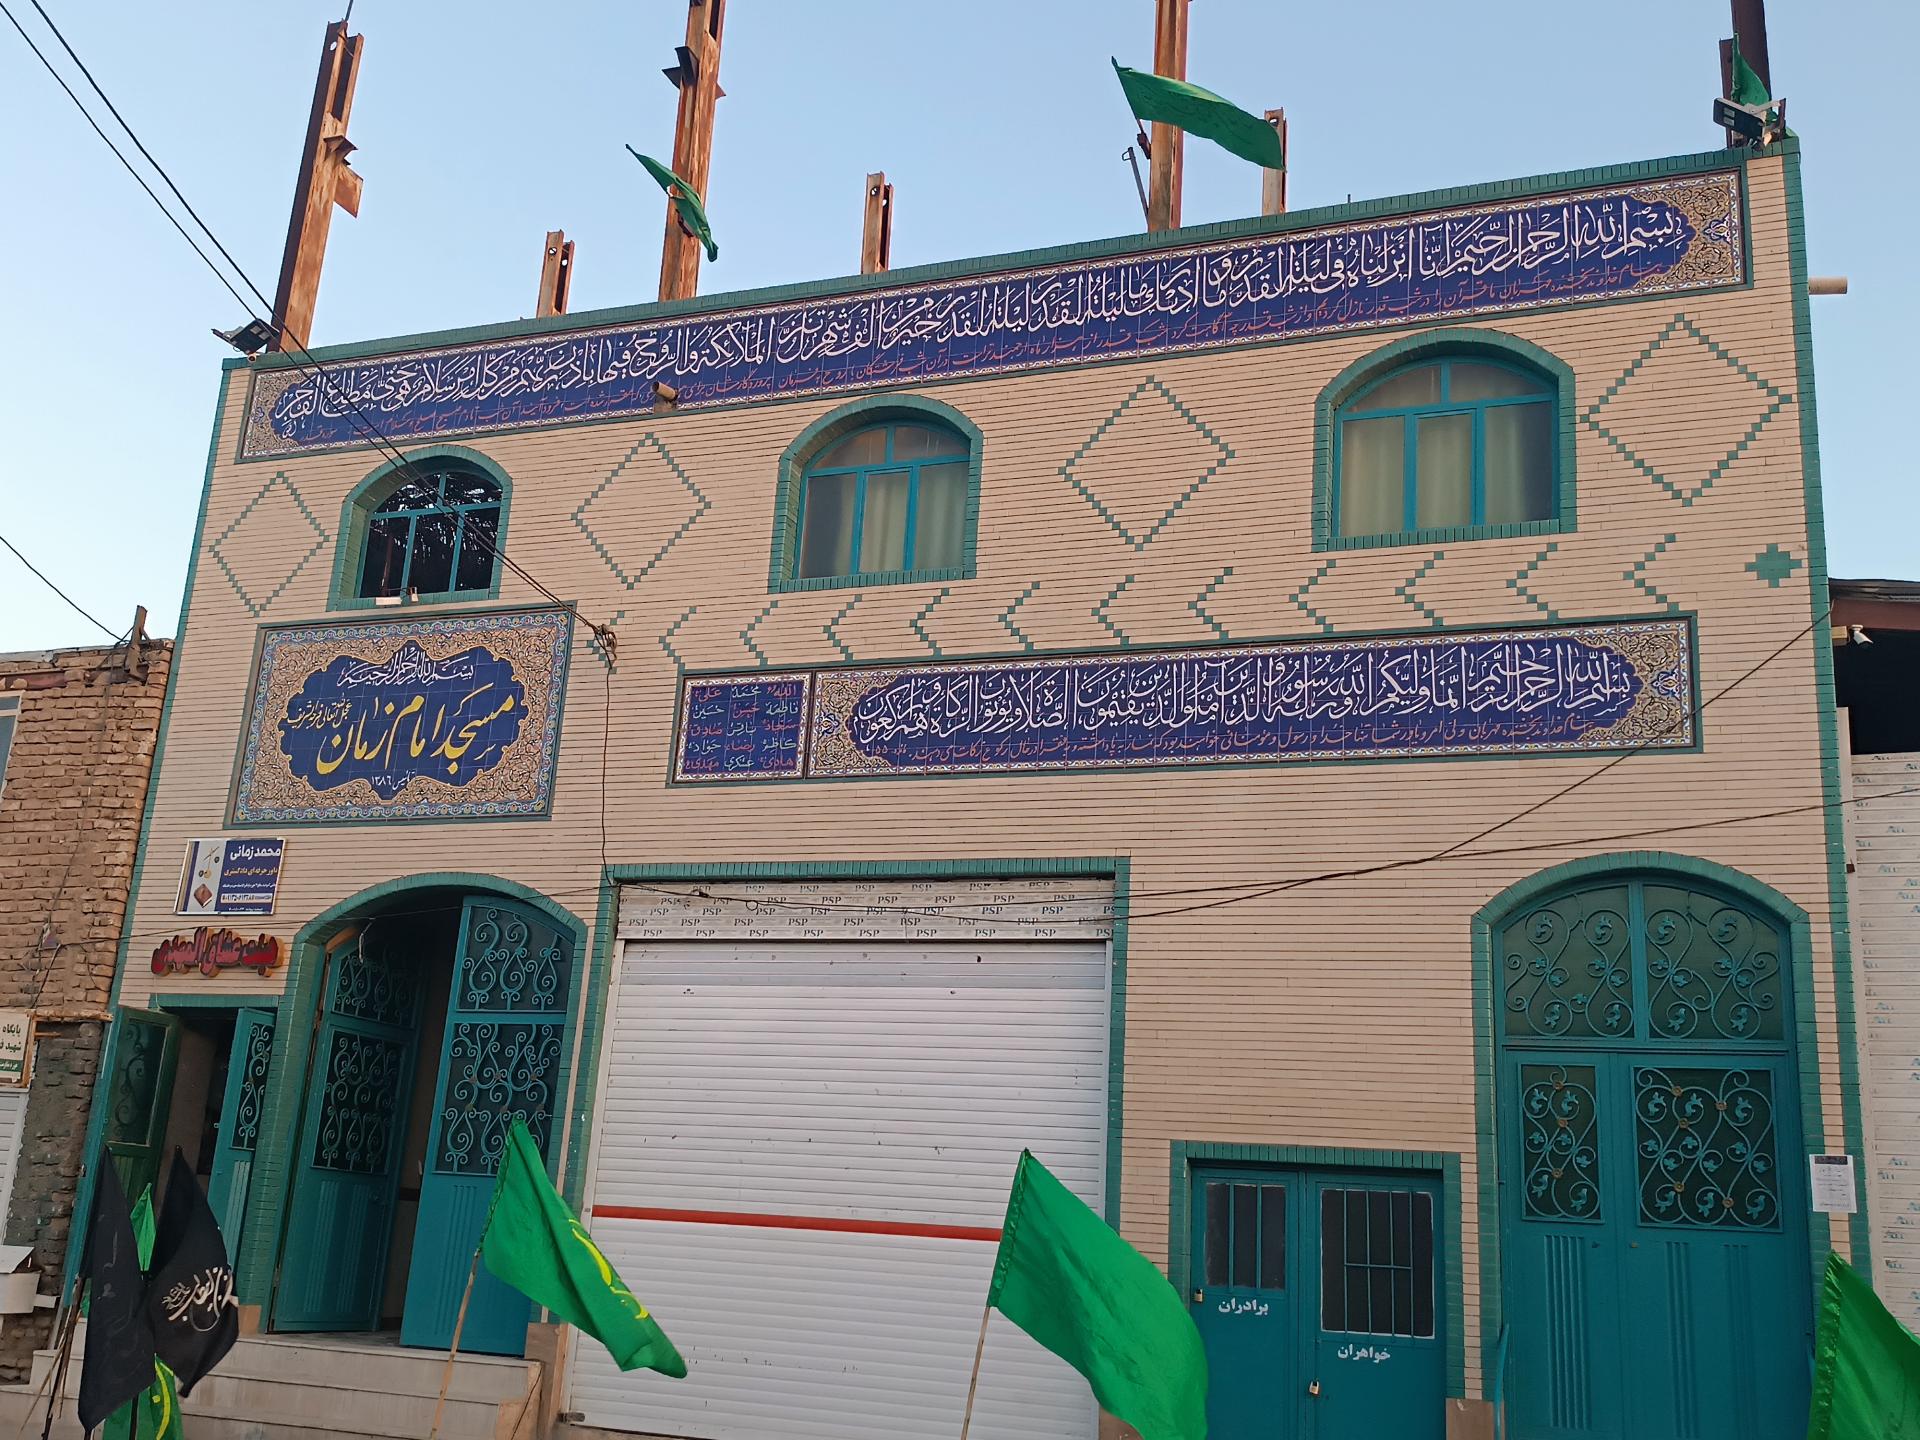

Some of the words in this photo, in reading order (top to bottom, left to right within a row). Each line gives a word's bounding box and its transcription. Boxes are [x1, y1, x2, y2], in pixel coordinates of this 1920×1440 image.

[731, 684, 762, 698] محمد
[384, 694, 447, 770] امام
[430, 686, 515, 775] مسجد
[316, 702, 393, 775] زمان
[230, 844, 254, 860] زمانی
[254, 847, 281, 857] محمد
[767, 896, 787, 905] PSP
[822, 896, 842, 905] PSP
[877, 895, 898, 904] PSP
[934, 895, 956, 904] PSP
[993, 894, 1015, 903] PSP
[650, 908, 669, 916] PSP
[702, 907, 722, 916] PSP
[756, 908, 776, 916] PSP
[981, 906, 1003, 915] PSP
[1041, 906, 1064, 915] PSP
[629, 918, 648, 927] PSP
[681, 918, 700, 927] PSP
[734, 918, 754, 927] PSP
[788, 918, 809, 927] PSP
[643, 928, 663, 937] PSP
[695, 929, 715, 937] PSP
[749, 929, 769, 937] PSP
[803, 929, 824, 937] PSP
[859, 929, 880, 937] PSP
[916, 928, 937, 937] PSP
[974, 928, 996, 937] PSP
[1034, 928, 1056, 937] PSP
[1218, 1298, 1269, 1316] برادران
[1337, 1343, 1391, 1364] خواهران
